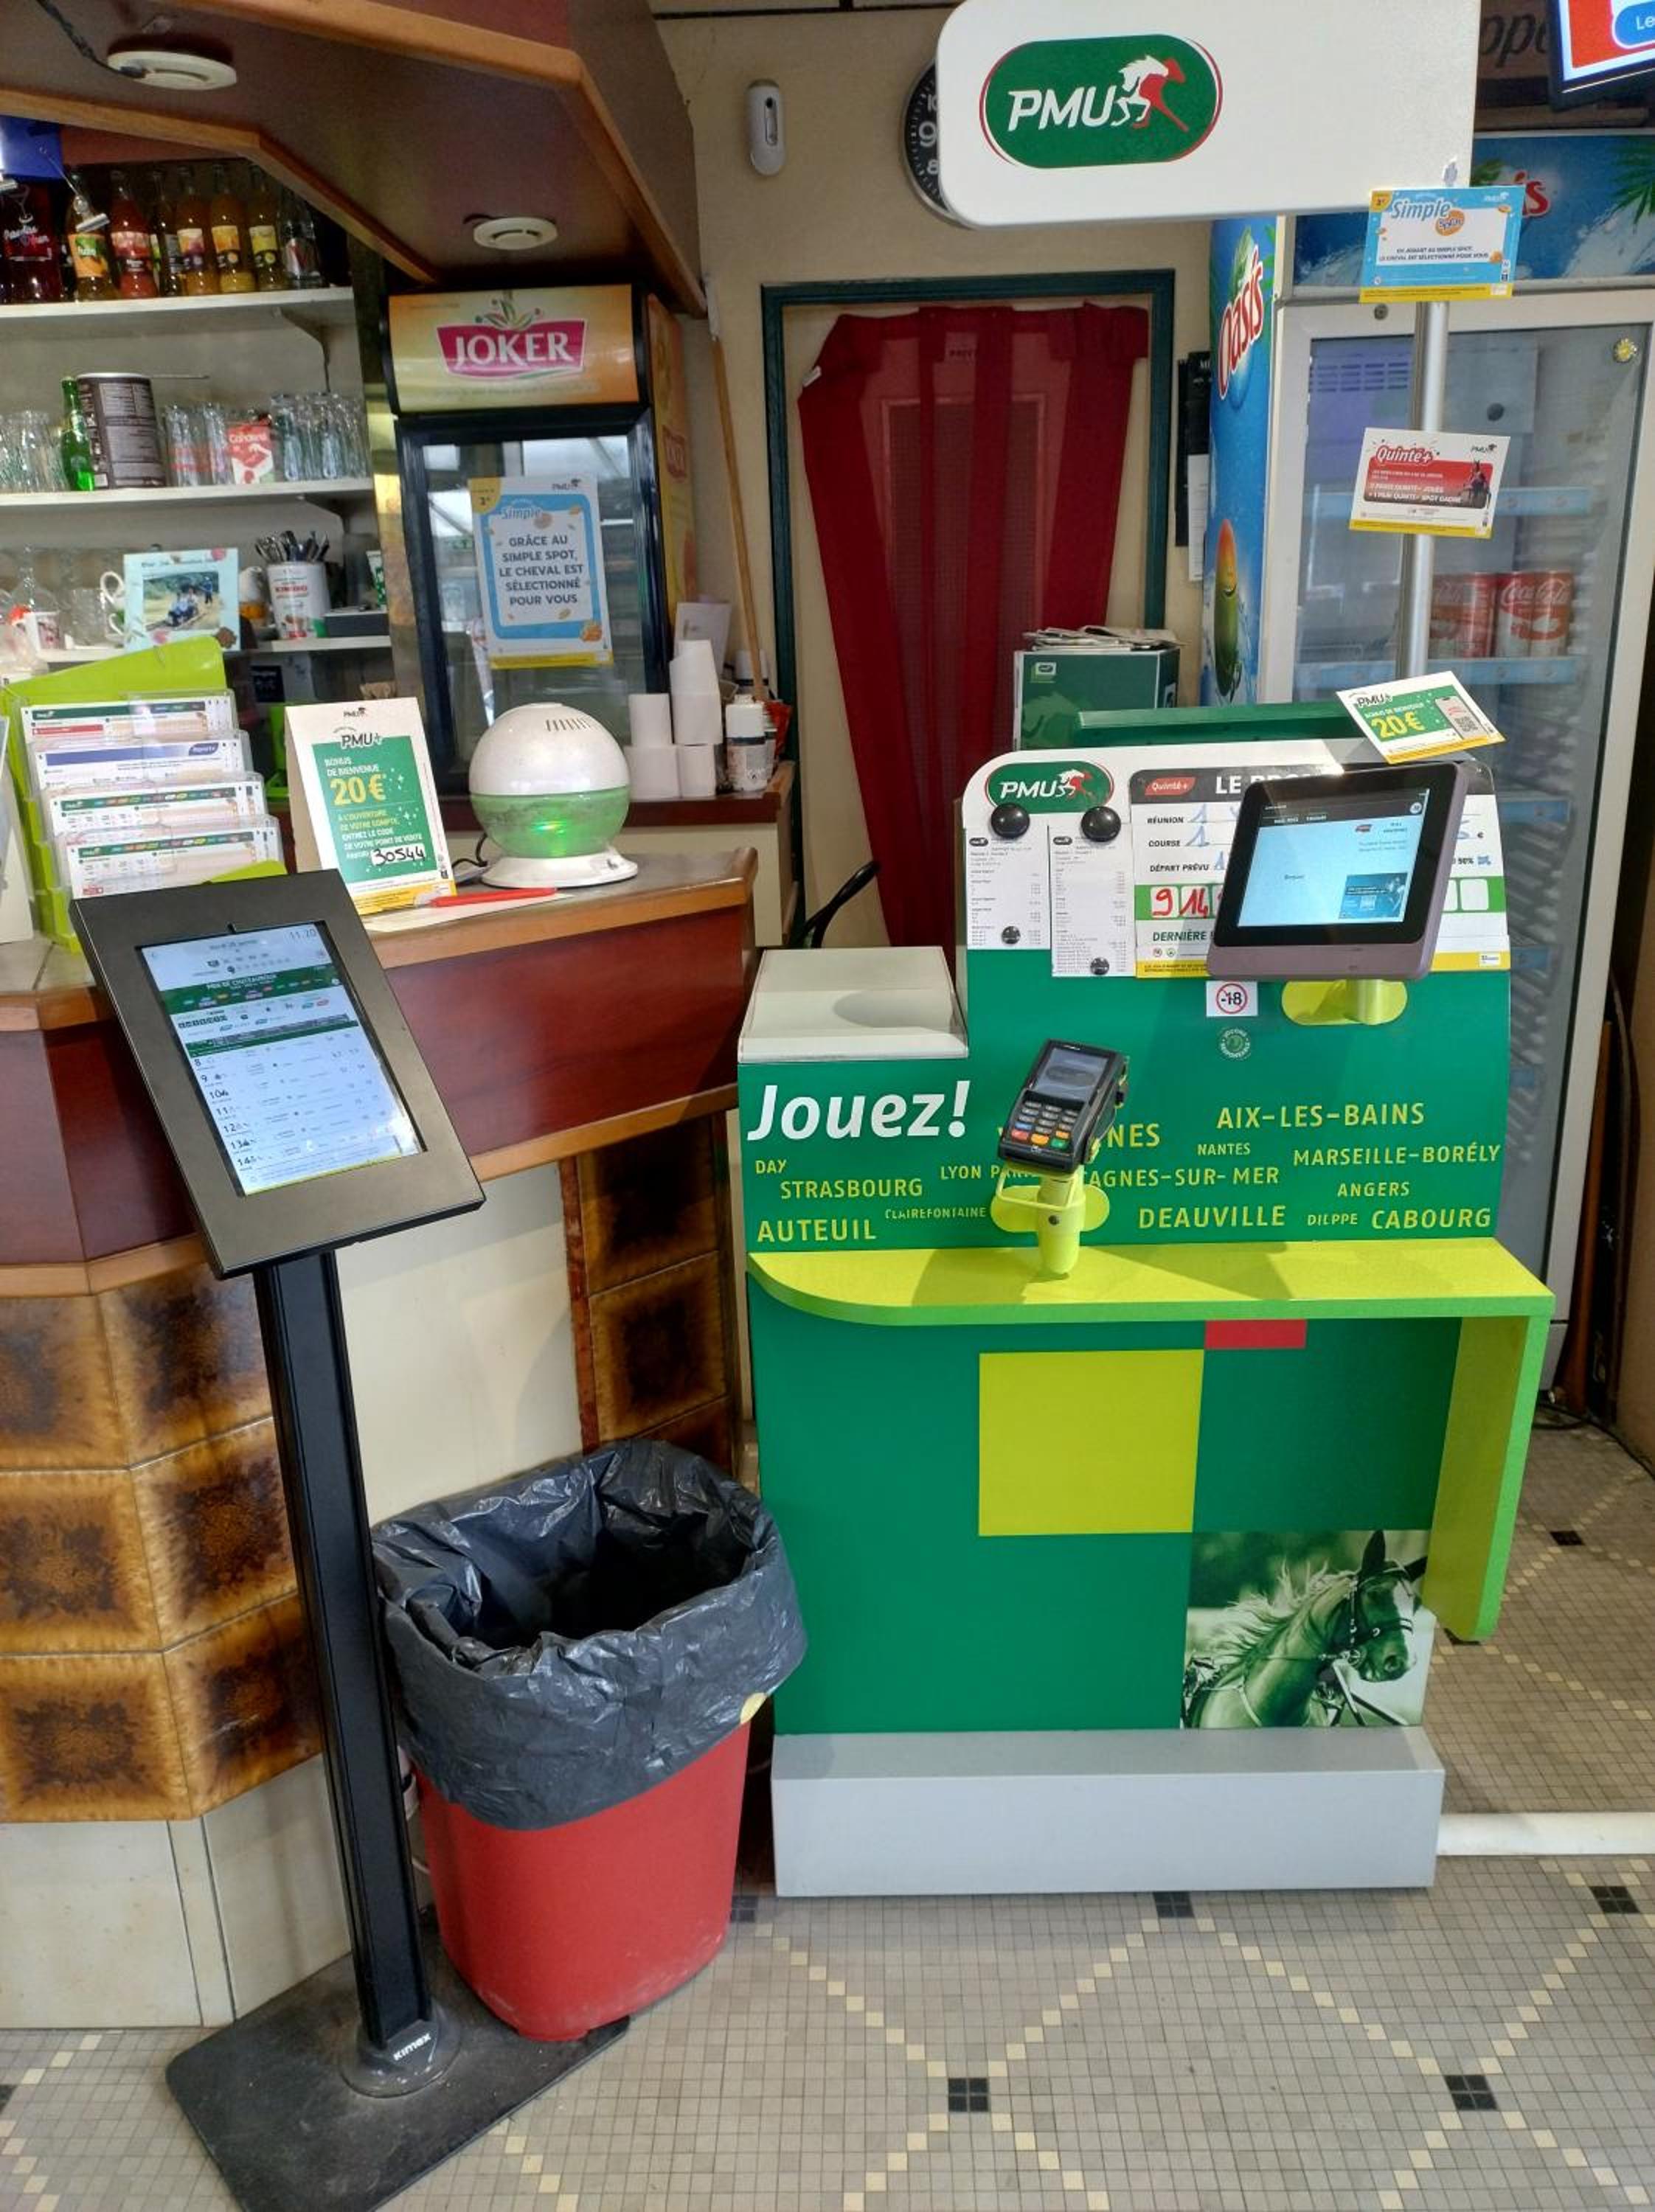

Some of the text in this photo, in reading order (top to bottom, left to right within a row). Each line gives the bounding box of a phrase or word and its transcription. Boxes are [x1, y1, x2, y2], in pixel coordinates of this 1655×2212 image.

[1008, 86, 1117, 132] PMU
[919, 121, 937, 147] 9
[1392, 198, 1451, 220] Simple
[456, 330, 573, 367] JOKER
[1376, 445, 1433, 464] Quinté+
[500, 505, 544, 521] Simple
[509, 534, 568, 546] GRÂCE AU
[502, 551, 543, 563] SIMPLE
[499, 564, 583, 577] LE CHEVAL EST
[505, 577, 581, 591] SÉLECTIONNÉ
[510, 594, 577, 606] POUR VOUS
[1371, 711, 1426, 739] 20€
[327, 768, 339, 777] DE
[1000, 782, 1058, 799] PMU
[1215, 776, 1241, 794] LE
[1147, 814, 1184, 824] RÉUNION
[1148, 840, 1181, 848] COURSE
[373, 847, 426, 866] 30544
[1150, 862, 1210, 872] DÉPART PRÉVU
[1152, 887, 1173, 917] 9
[1153, 928, 1207, 942] DERNIÈRE
[1221, 992, 1242, 1005] -18
[747, 1080, 971, 1141] Jouez!
[1216, 1102, 1425, 1130] AIX-LES-BAINS
[223, 1123, 237, 1133] 12
[1197, 1143, 1251, 1156] NANTES
[1293, 1142, 1501, 1167] MARSEILLE-BORÉLY
[754, 1159, 787, 1175] DAY
[940, 1165, 982, 1180] LYON
[1085, 1167, 1280, 1189] AGNES-SUR-MER
[780, 1178, 923, 1200] STRASBOURG
[1337, 1181, 1410, 1198] ANGERS
[885, 1207, 987, 1220] CLAIREFONTAINE
[1138, 1205, 1286, 1230] DEAUVILLE
[1371, 1207, 1491, 1231] CABOURG
[757, 1218, 877, 1243] AUTEUIL
